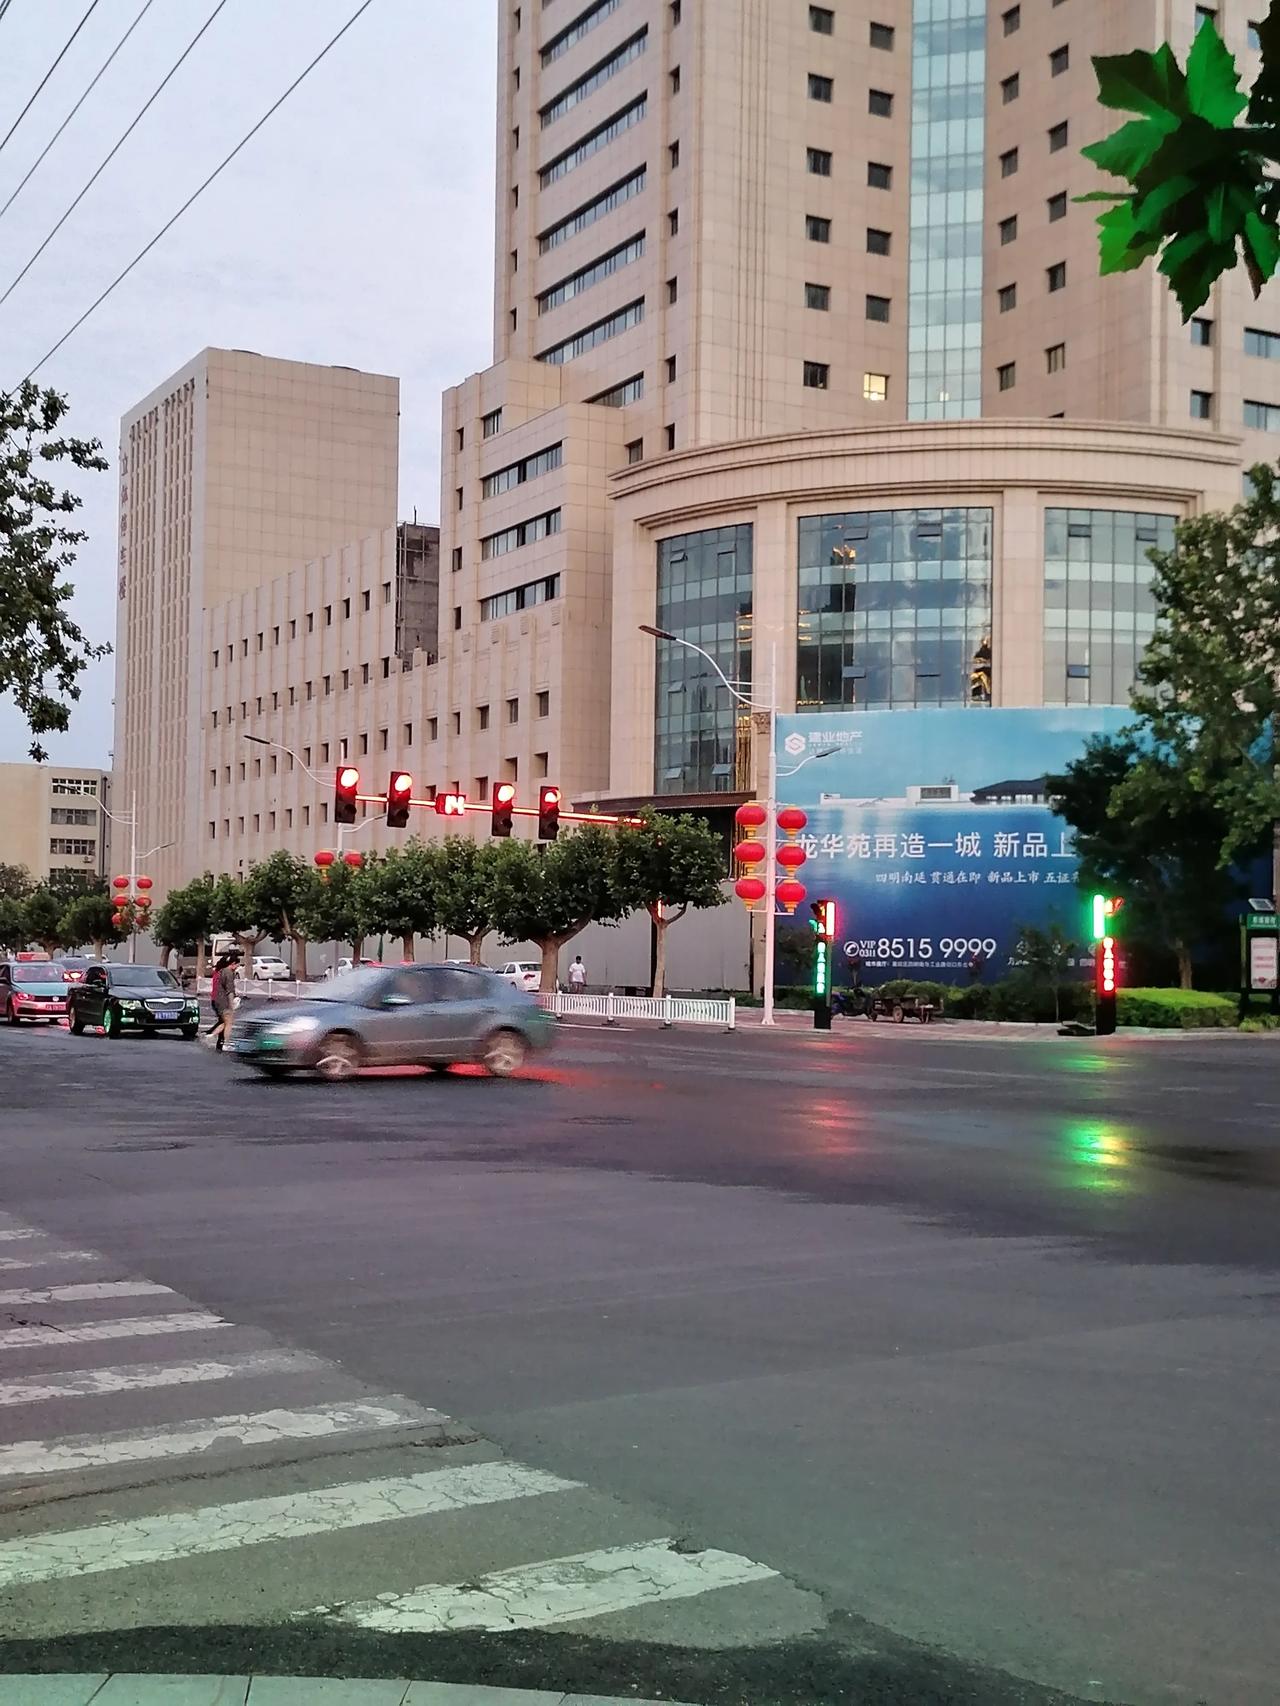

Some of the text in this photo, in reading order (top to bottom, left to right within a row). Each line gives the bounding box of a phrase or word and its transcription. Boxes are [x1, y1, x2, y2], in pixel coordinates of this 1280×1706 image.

[795, 832, 982, 859] 龙华苑再造一城
[930, 871, 982, 885] 贯通在即
[987, 871, 1040, 884] 新品上市
[860, 940, 877, 949] VIP
[877, 938, 997, 959] 8515 9999
[859, 949, 876, 958] 0311
